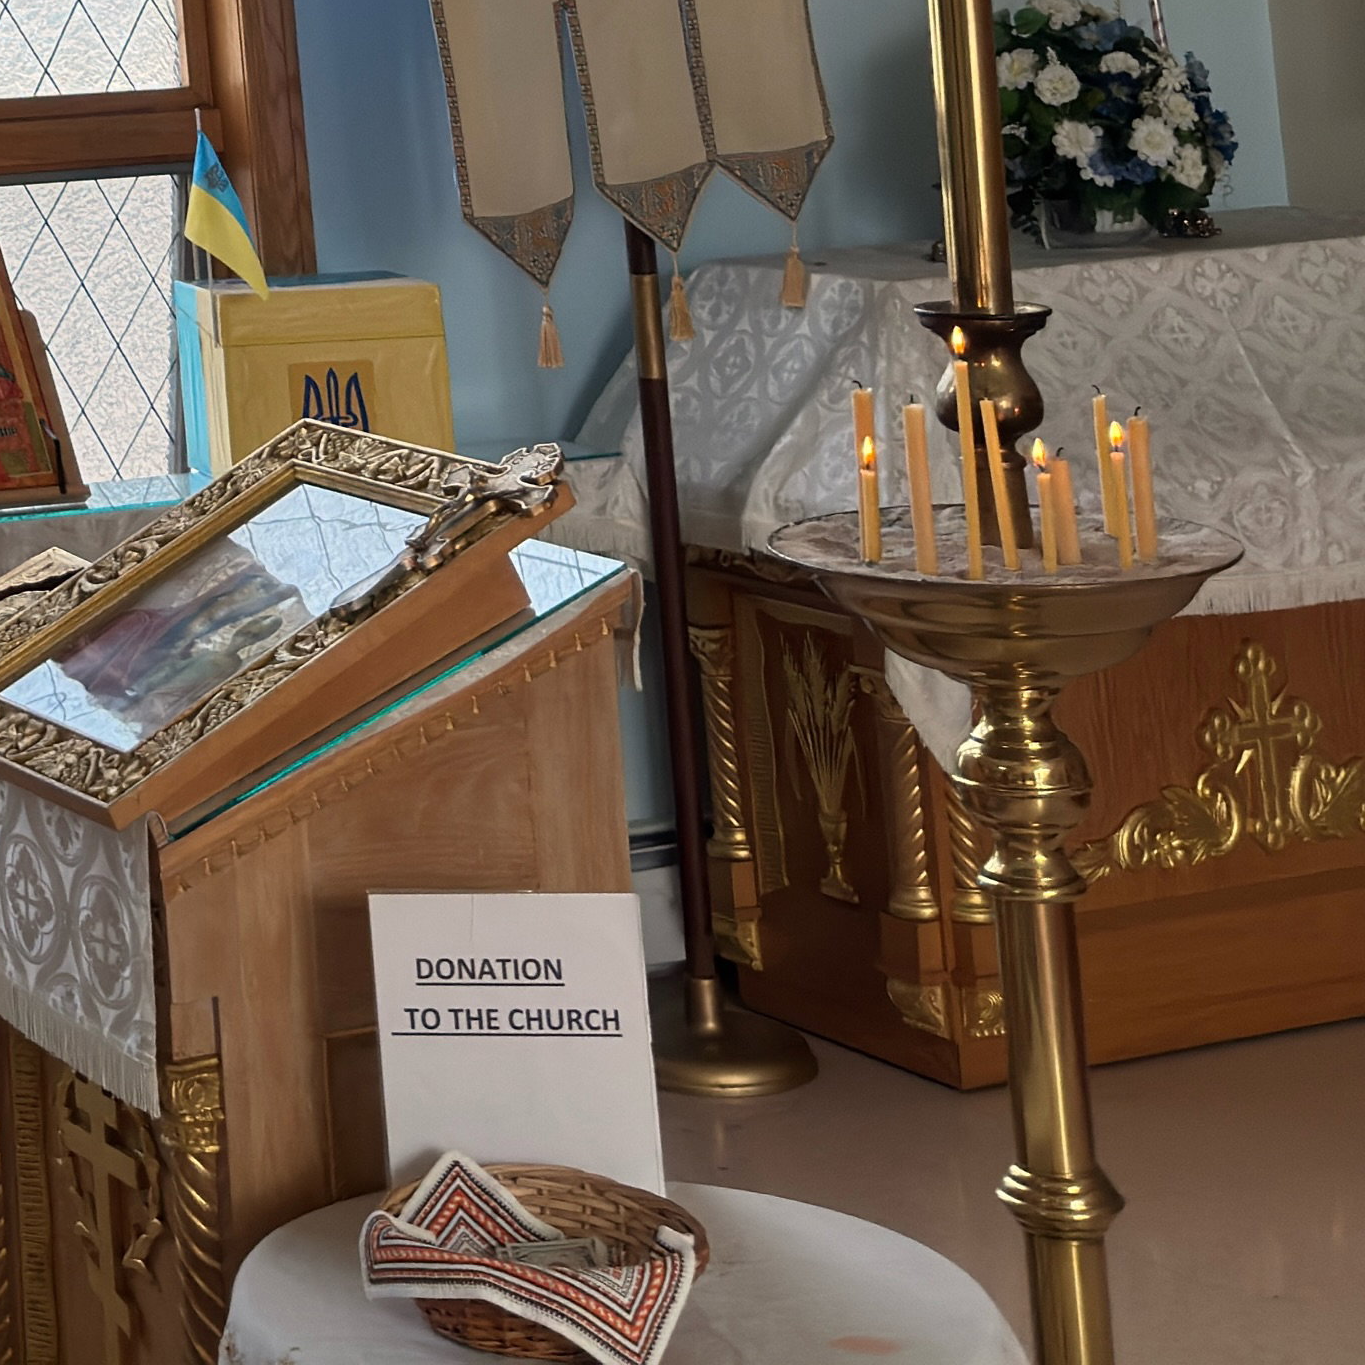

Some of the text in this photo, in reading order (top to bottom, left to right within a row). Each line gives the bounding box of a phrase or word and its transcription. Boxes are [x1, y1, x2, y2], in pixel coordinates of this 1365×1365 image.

[415, 957, 564, 981] DONATION
[403, 1007, 620, 1031] TO THE CHURCH
